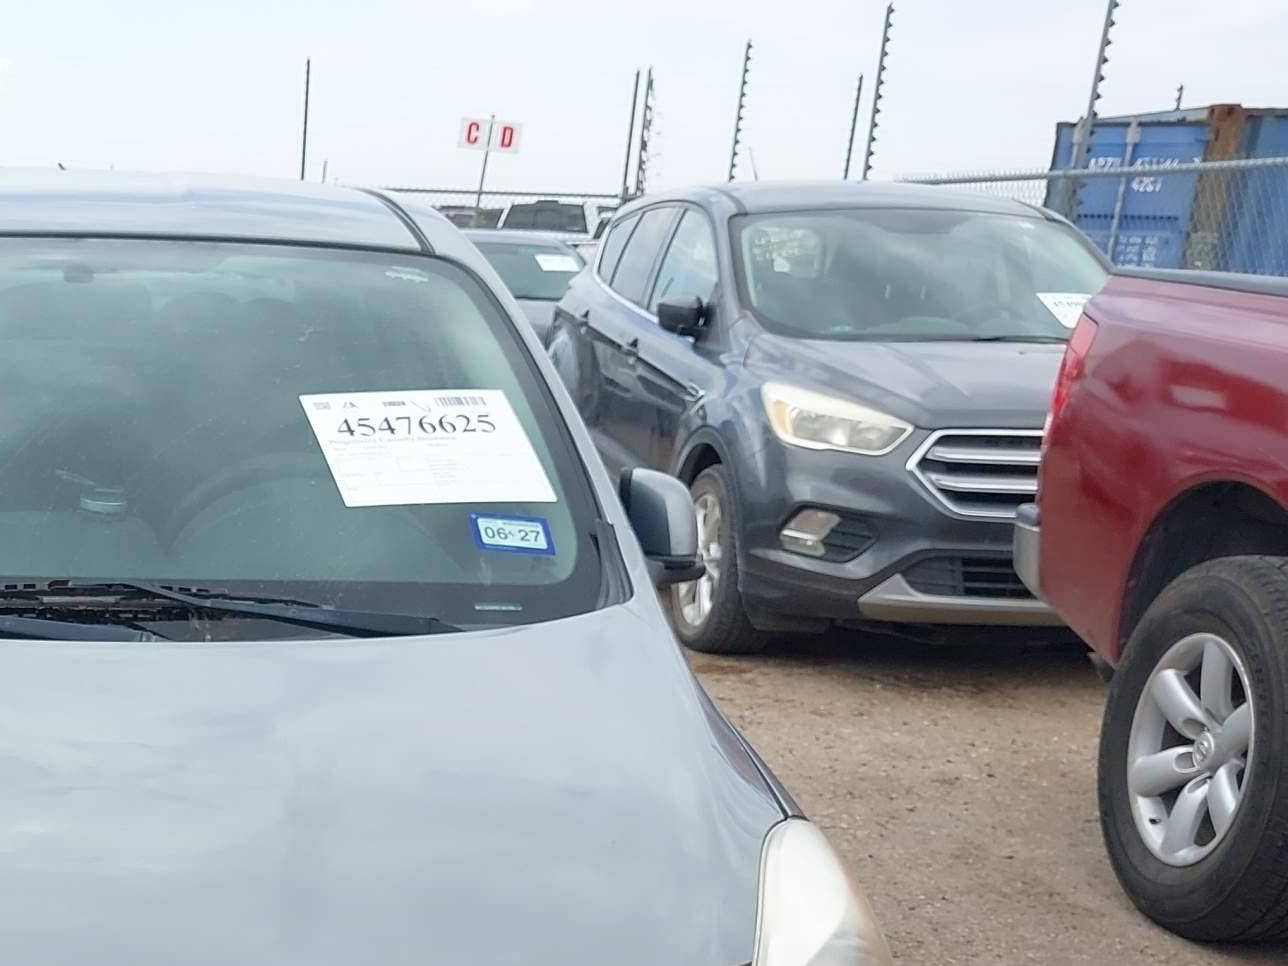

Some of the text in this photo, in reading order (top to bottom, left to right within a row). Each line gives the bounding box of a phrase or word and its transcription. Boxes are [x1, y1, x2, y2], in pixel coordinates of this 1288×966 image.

[467, 121, 480, 144] C
[500, 126, 514, 148] D
[337, 413, 497, 437] 45476625
[484, 525, 541, 543] 06 27
